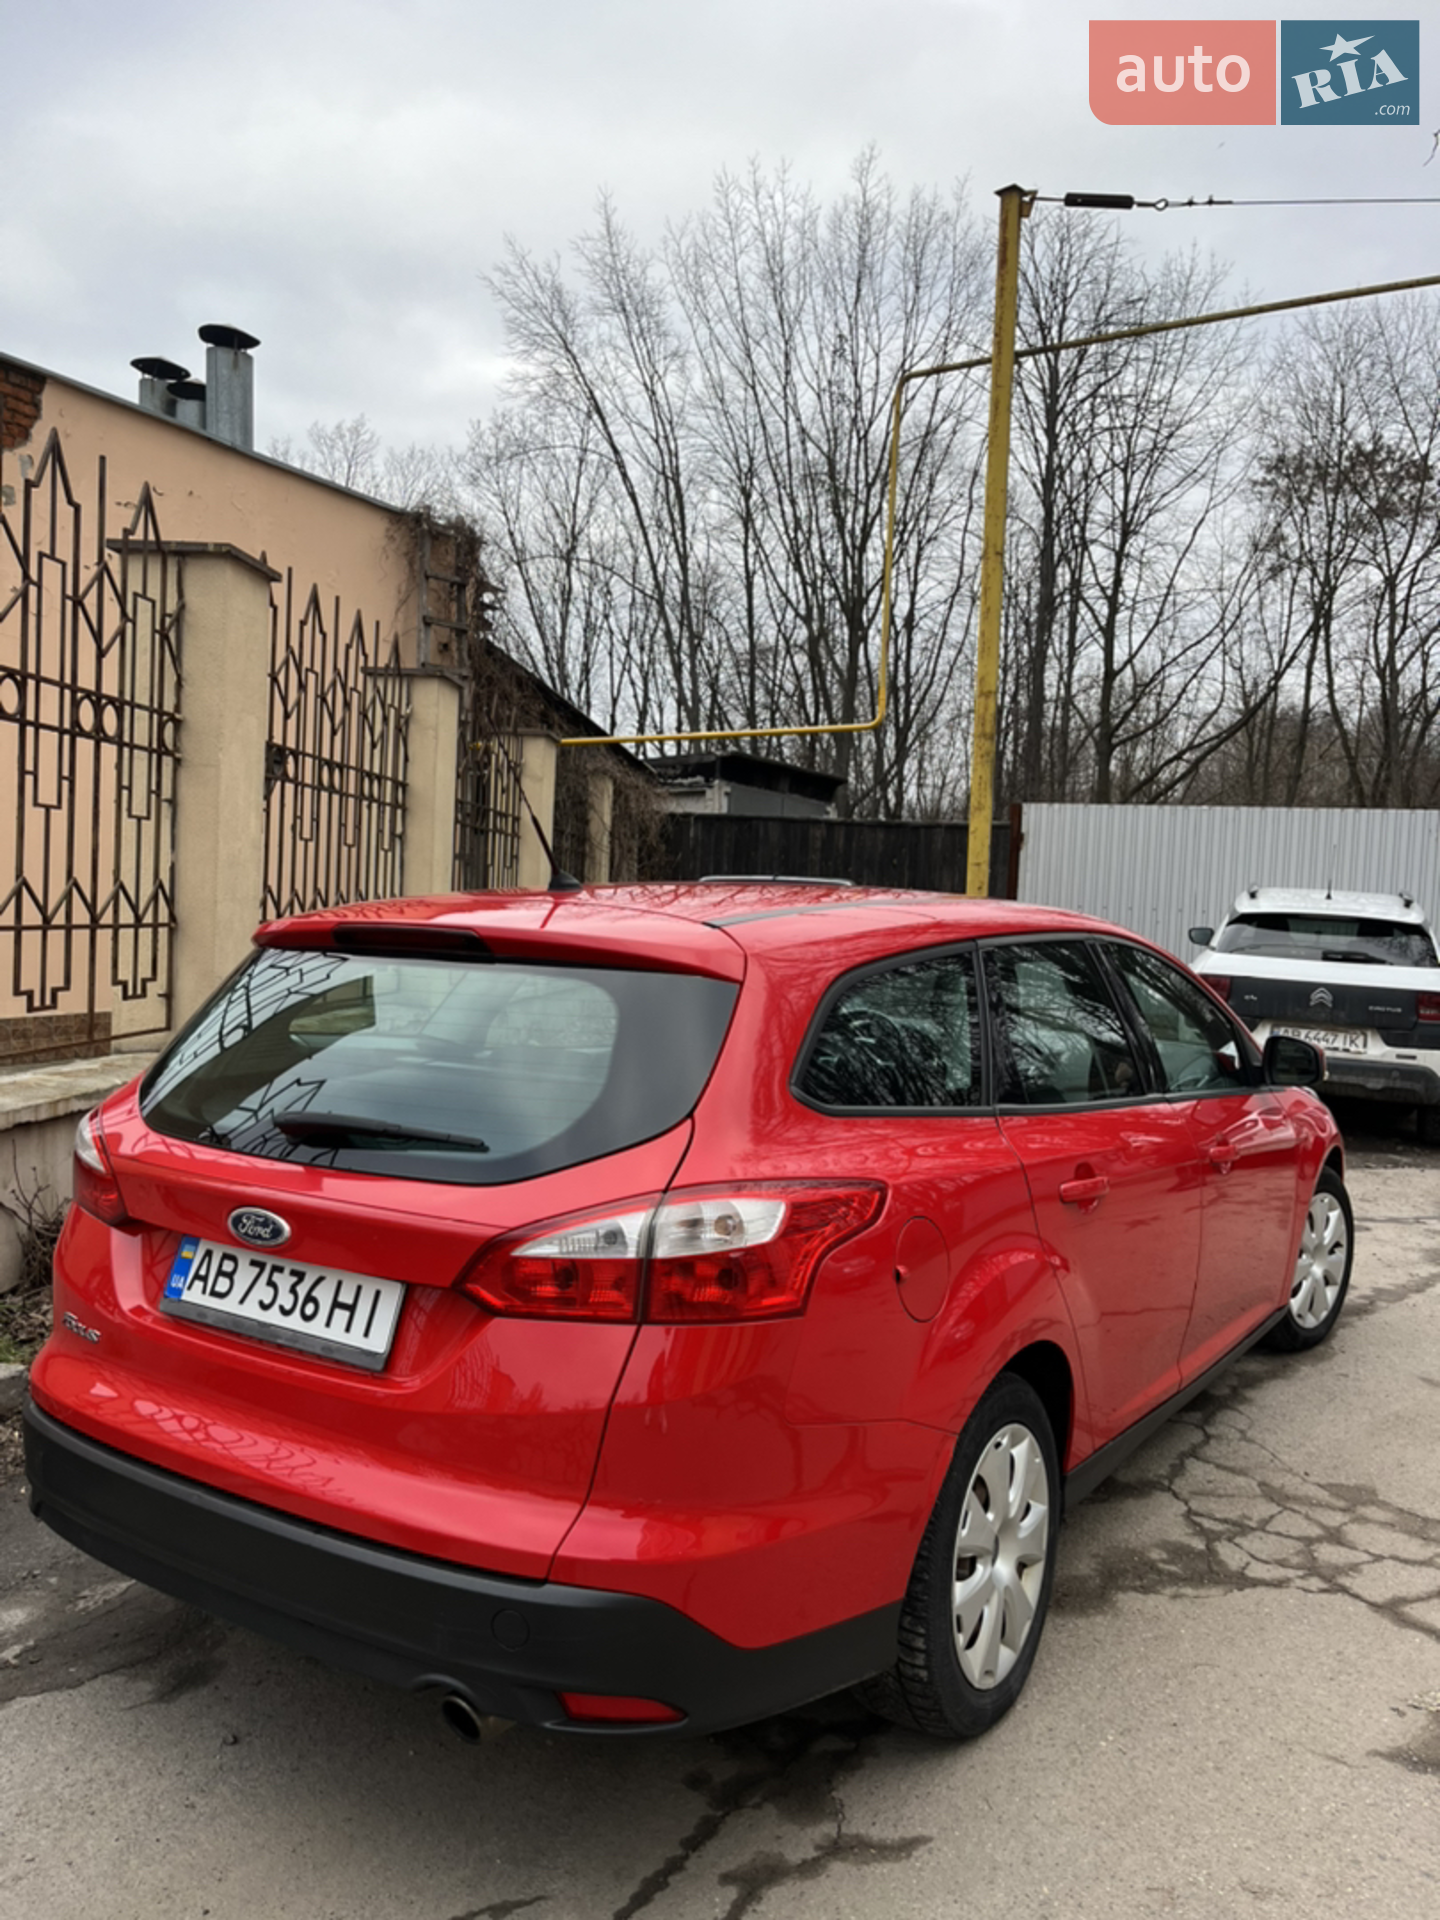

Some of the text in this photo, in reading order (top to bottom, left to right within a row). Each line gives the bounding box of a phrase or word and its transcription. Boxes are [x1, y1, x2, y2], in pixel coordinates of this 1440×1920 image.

[238, 1213, 273, 1238] Ford
[170, 1273, 185, 1290] UA
[186, 1248, 239, 1300] AB
[238, 1258, 327, 1323] 7536
